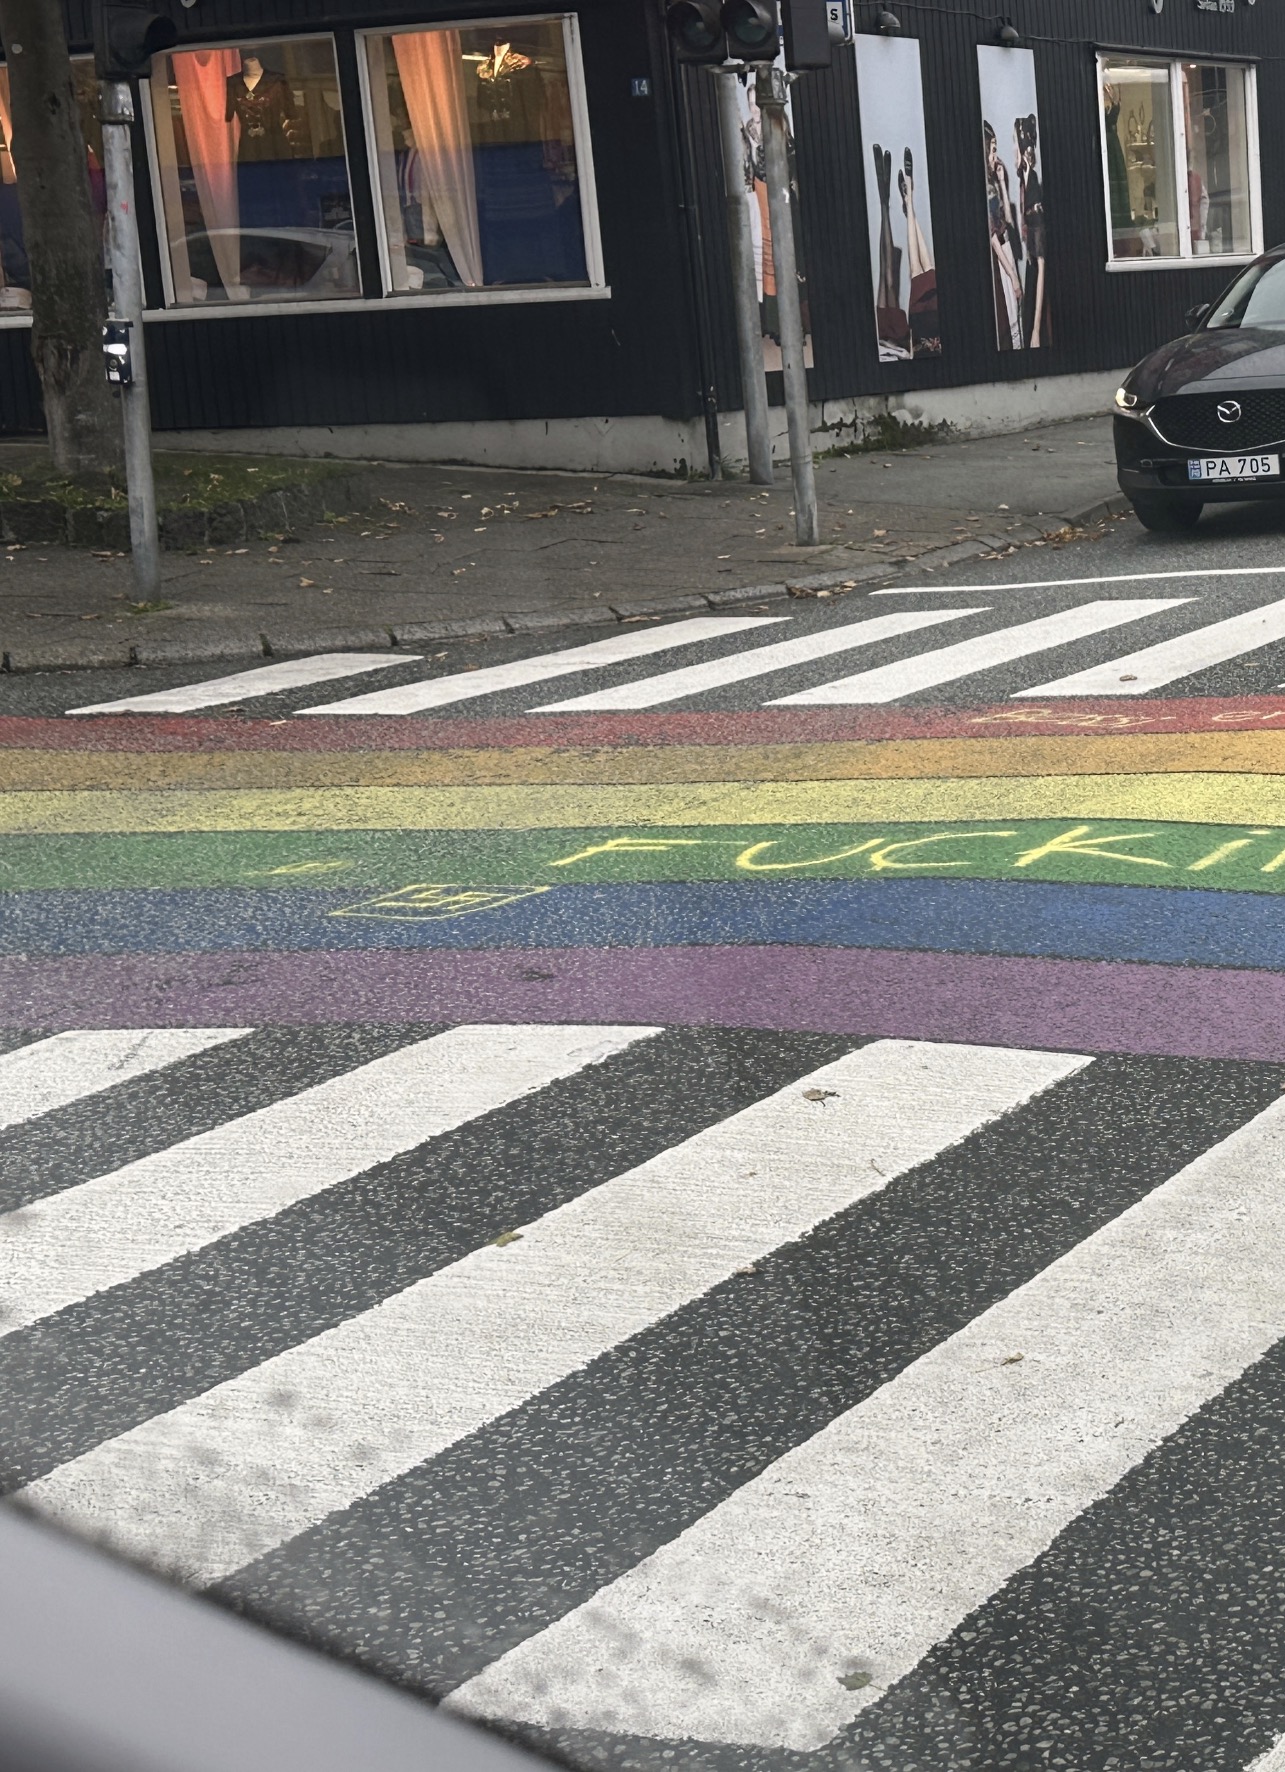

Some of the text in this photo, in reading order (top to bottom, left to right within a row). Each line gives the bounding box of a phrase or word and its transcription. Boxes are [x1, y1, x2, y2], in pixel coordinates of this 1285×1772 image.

[635, 79, 648, 95] 14
[1206, 460, 1231, 476] PA
[1238, 457, 1271, 475] 705
